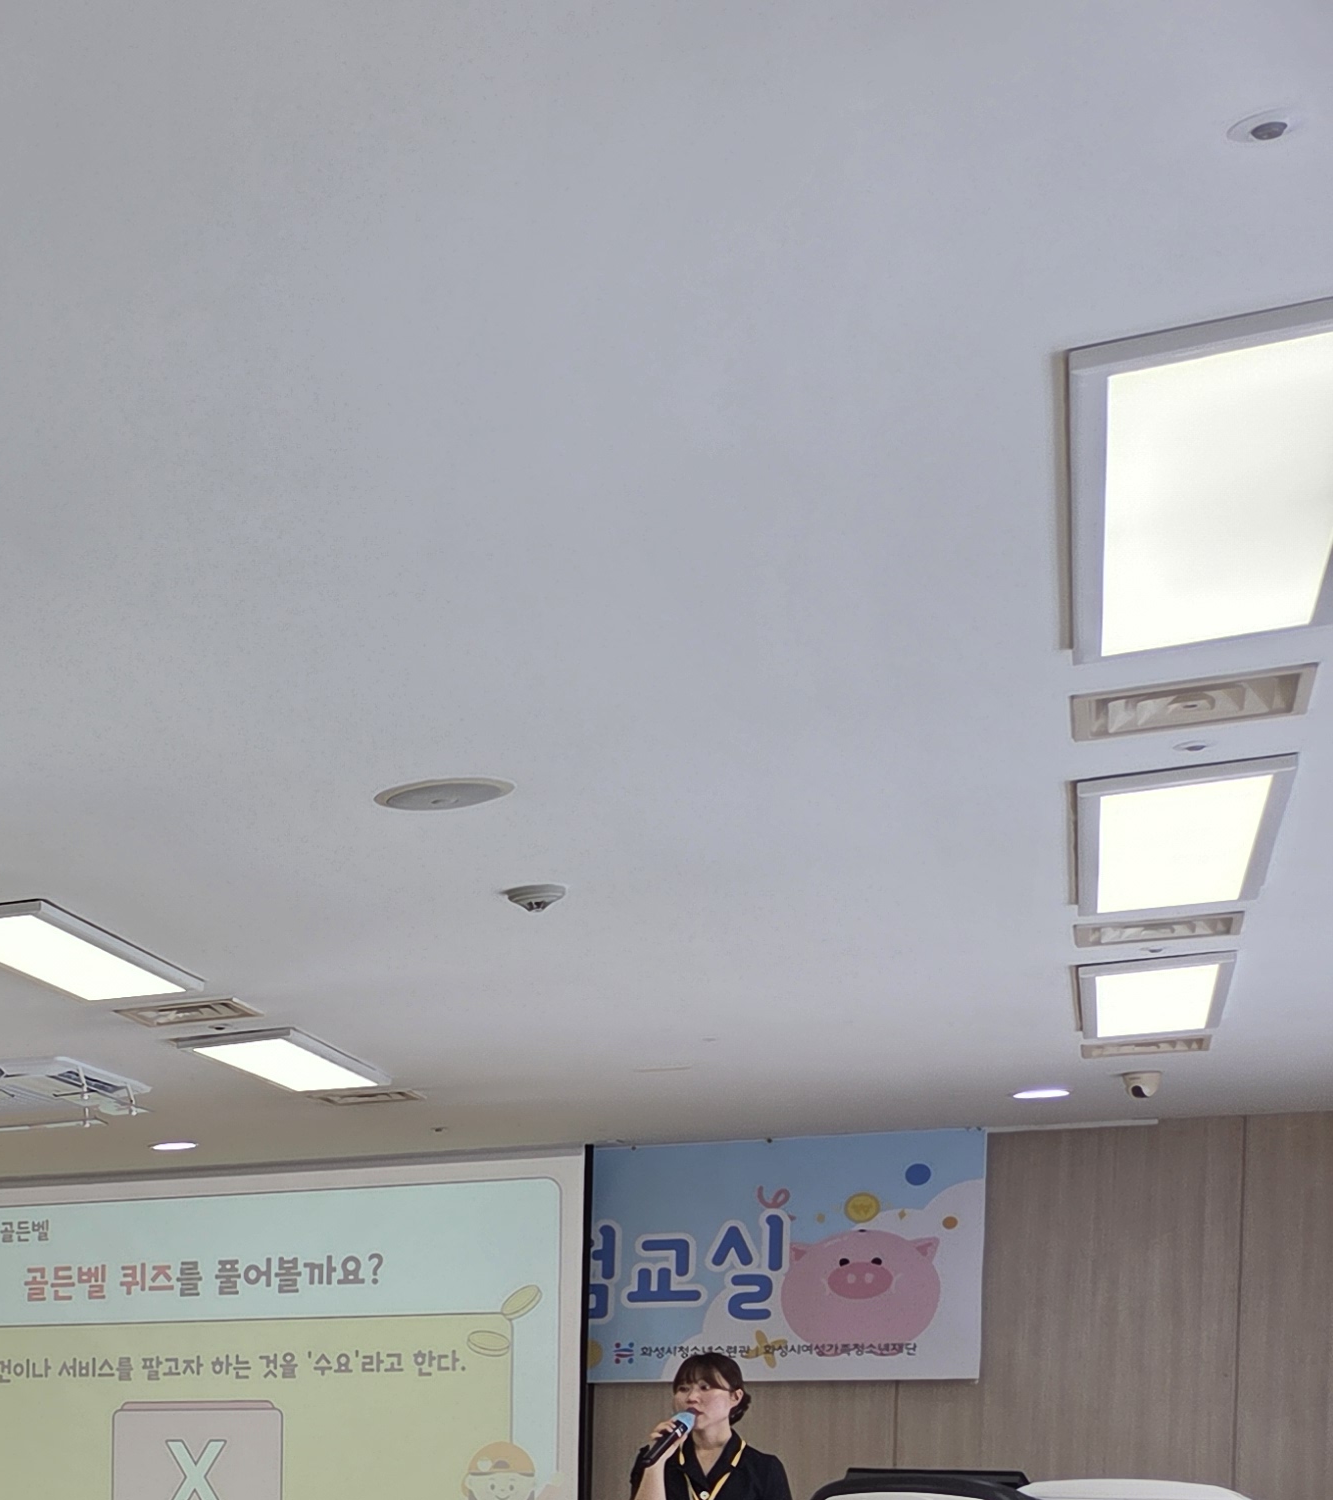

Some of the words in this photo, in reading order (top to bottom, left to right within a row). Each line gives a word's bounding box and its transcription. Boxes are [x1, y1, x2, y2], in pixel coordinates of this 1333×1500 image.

[0, 1219, 49, 1243] 골든벨
[23, 1263, 106, 1302] 골든벨
[119, 1261, 203, 1297] 퀴즈를
[214, 1252, 384, 1296] 풀어볼까요?
[58, 1356, 133, 1382] 서비스를
[141, 1355, 204, 1382] 팔고자
[211, 1354, 252, 1380] 하는
[259, 1352, 298, 1379] 것을
[307, 1349, 404, 1377] '수요'라고
[412, 1349, 467, 1377] 한다.
